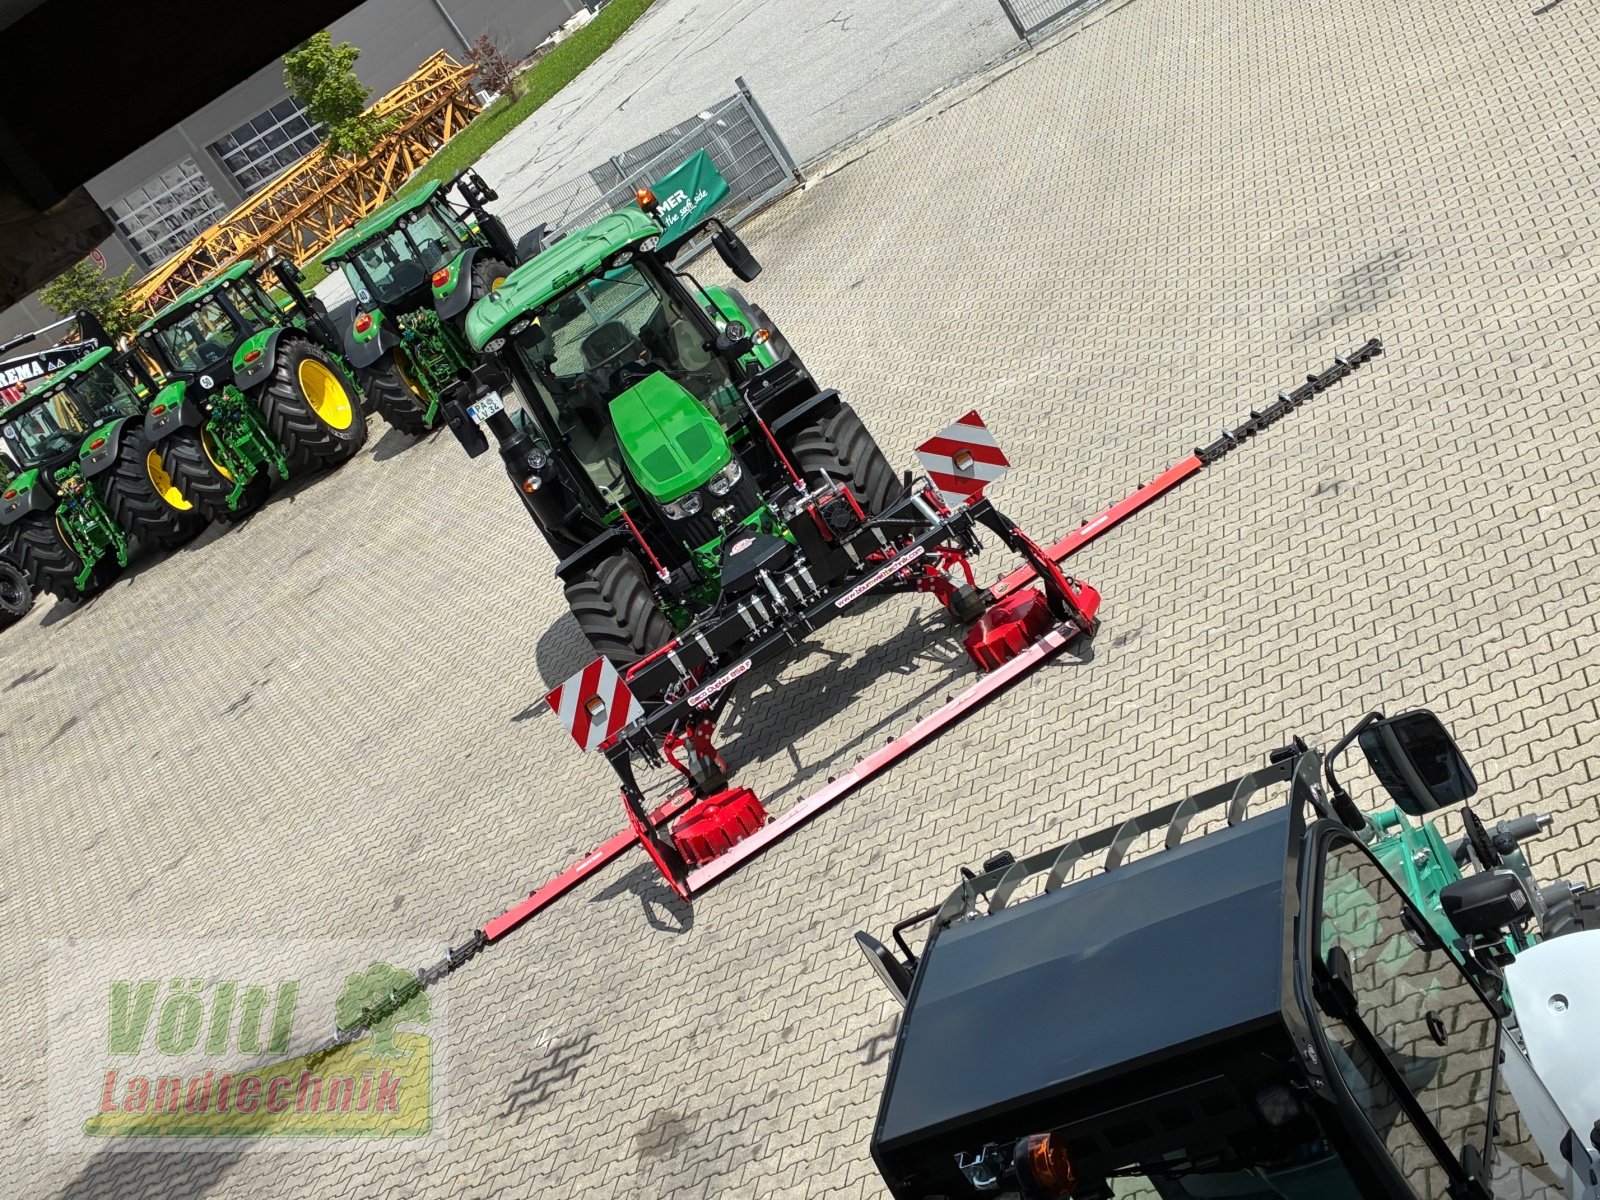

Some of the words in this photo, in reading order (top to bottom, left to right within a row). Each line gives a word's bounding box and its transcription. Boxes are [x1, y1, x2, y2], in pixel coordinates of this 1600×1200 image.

[656, 190, 688, 217] MER
[665, 213, 679, 227] the
[680, 198, 697, 216] safe
[694, 189, 708, 204] side
[475, 402, 487, 411] PA
[476, 409, 488, 421] LV
[488, 402, 499, 413] 34
